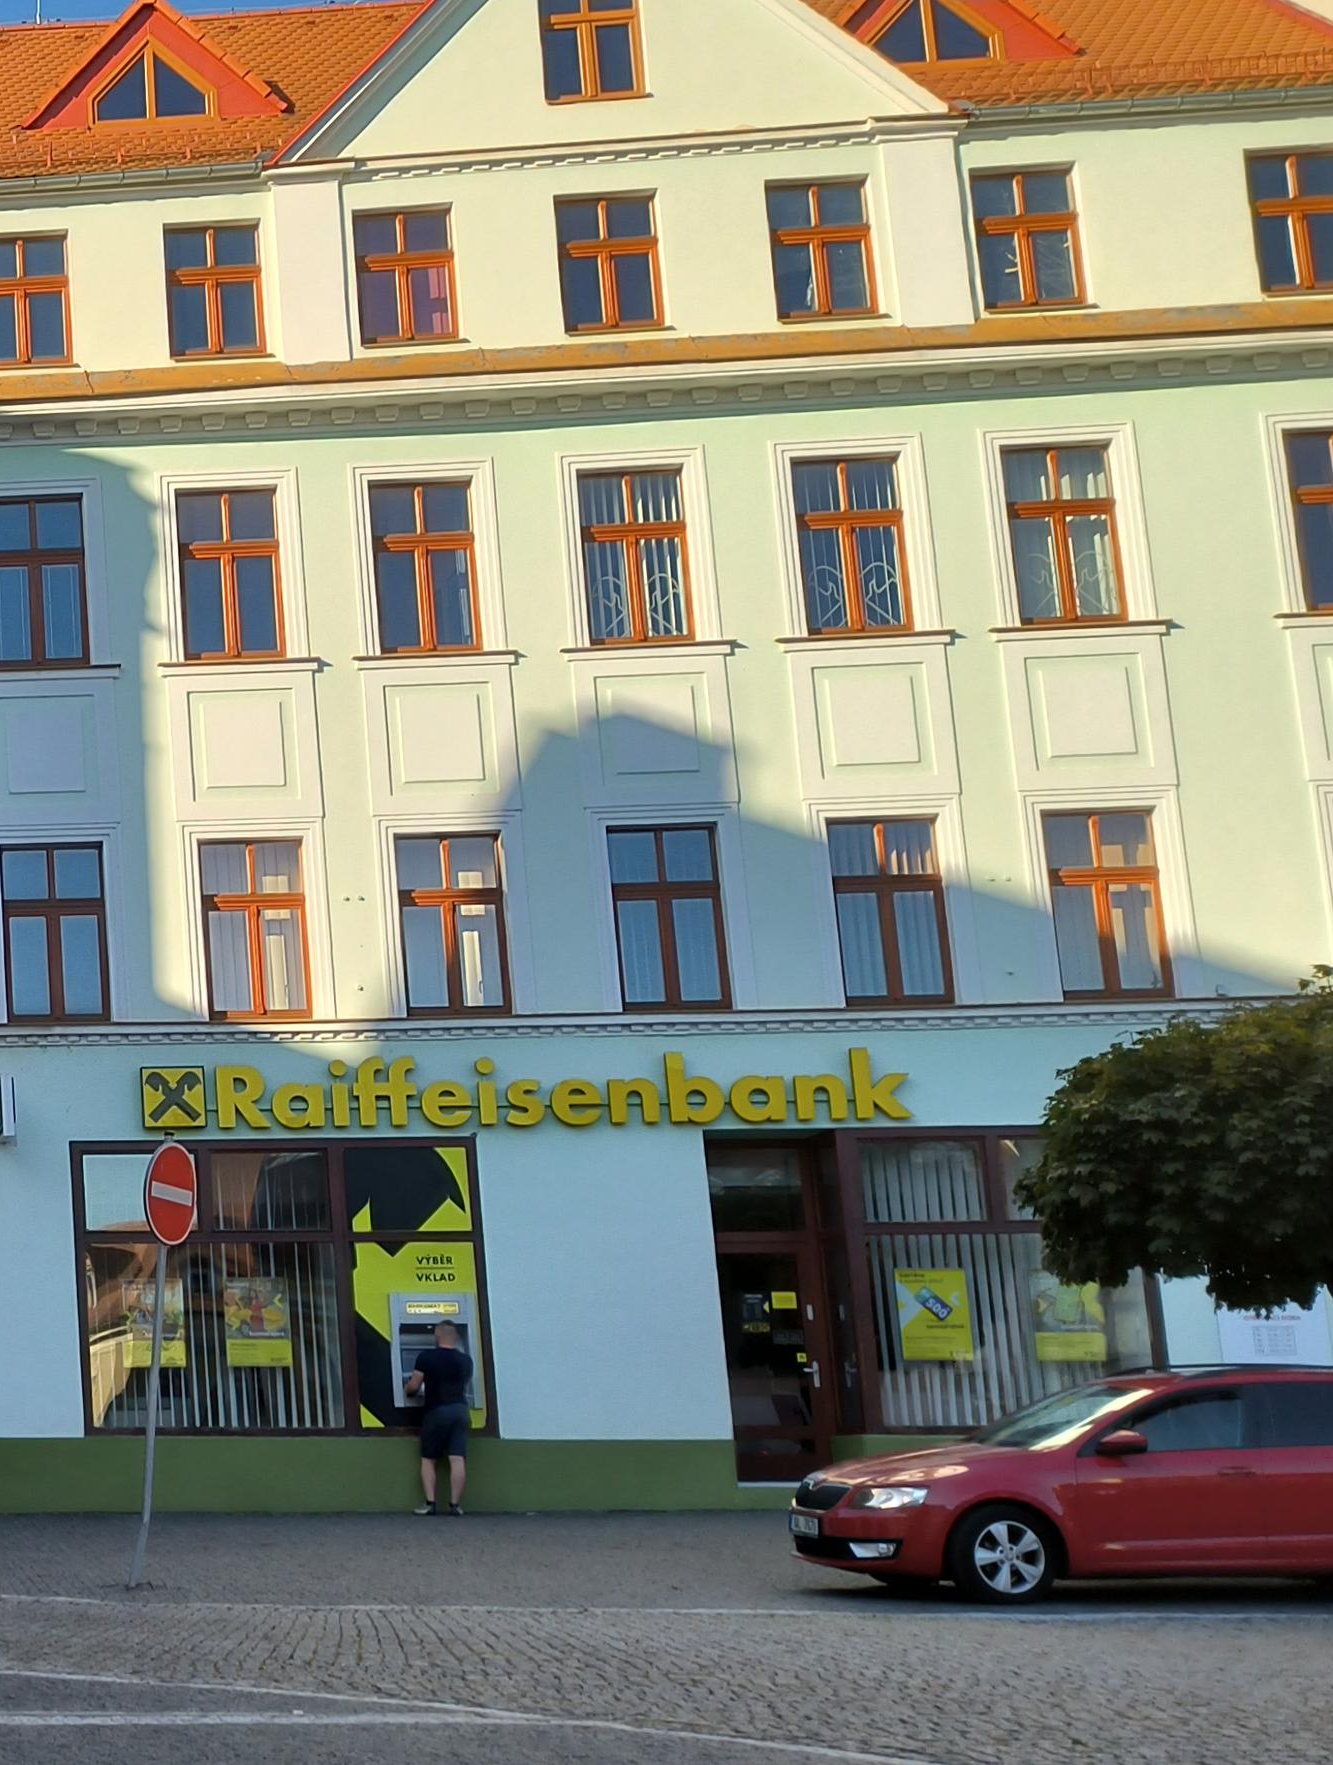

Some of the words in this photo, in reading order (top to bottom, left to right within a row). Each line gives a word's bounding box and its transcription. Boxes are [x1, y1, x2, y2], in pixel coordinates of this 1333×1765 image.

[215, 1047, 914, 1129] Raiffeisenbank
[416, 1253, 453, 1265] VÝBĚR
[416, 1273, 456, 1282] VKLAD
